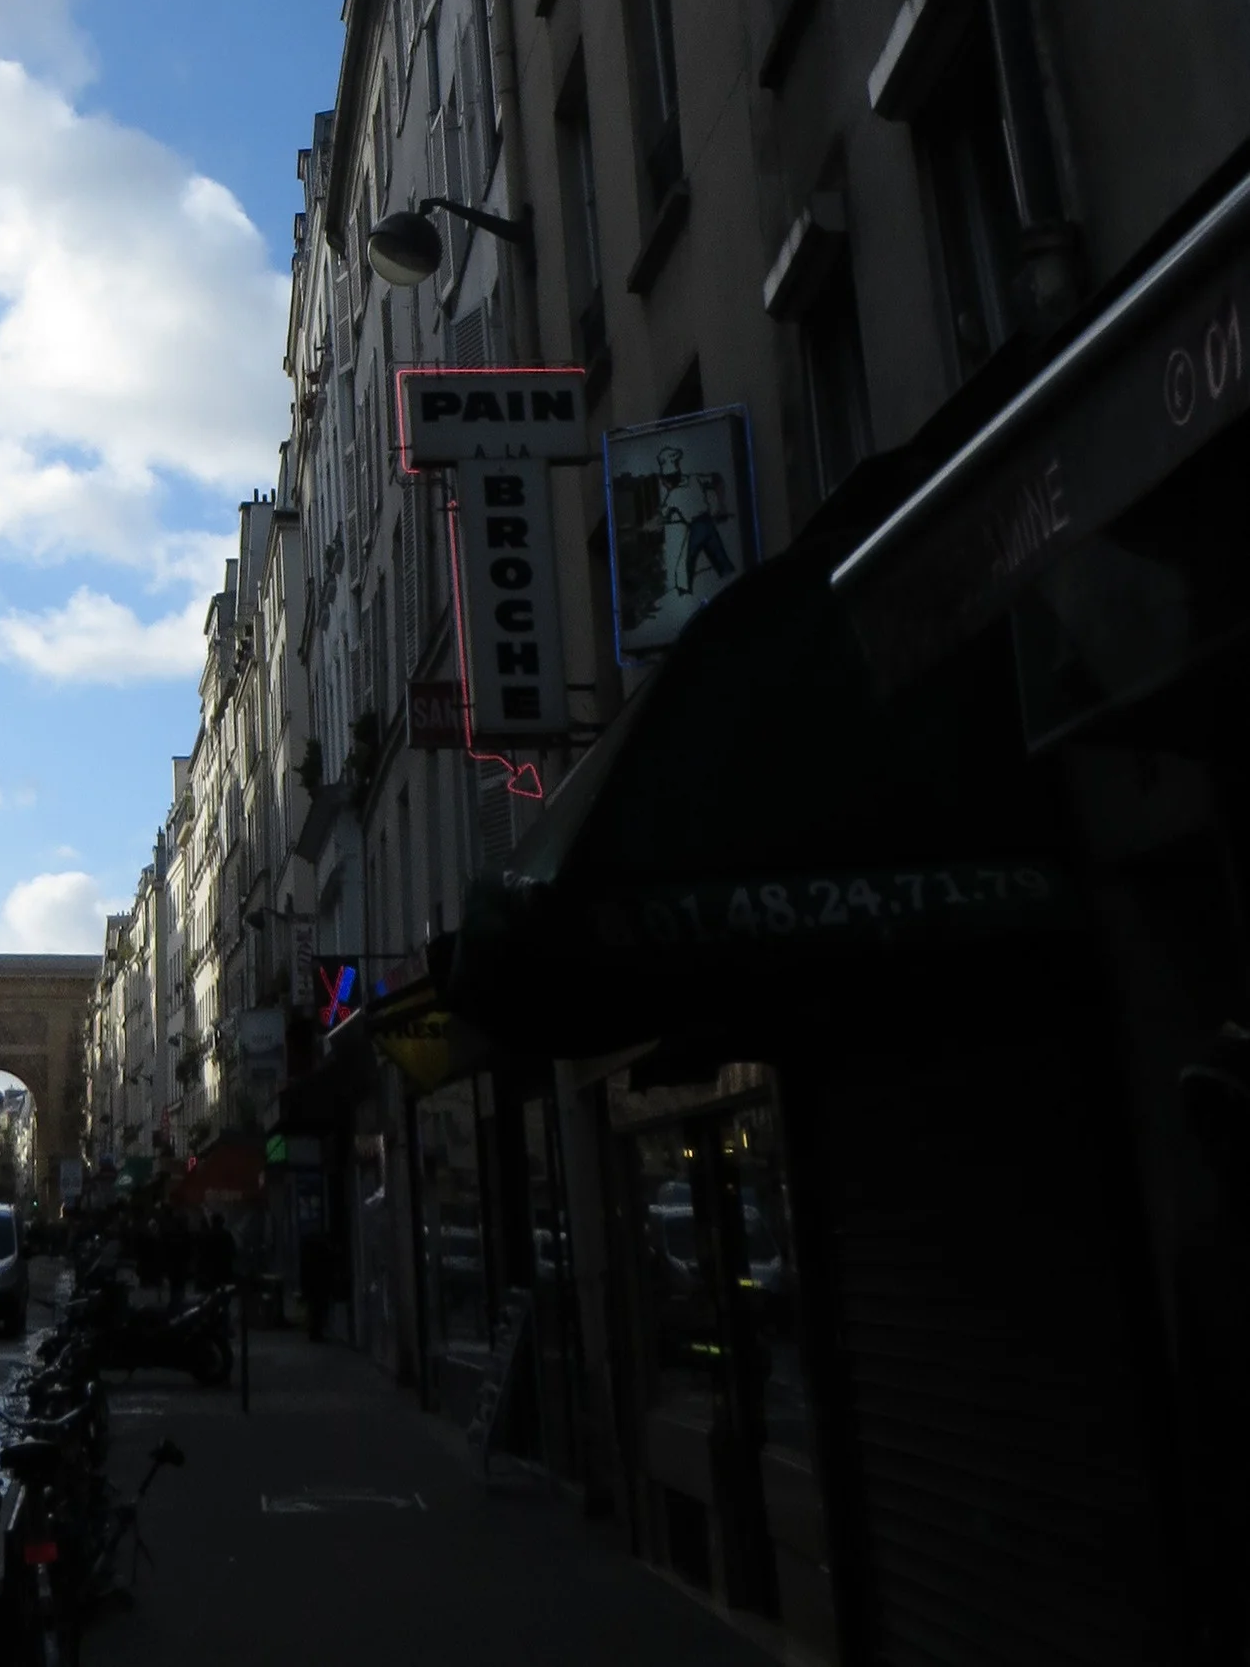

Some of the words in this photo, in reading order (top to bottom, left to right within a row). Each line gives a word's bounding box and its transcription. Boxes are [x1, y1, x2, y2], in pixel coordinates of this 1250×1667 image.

[421, 390, 575, 422] PAIN
[505, 442, 531, 459] LA
[483, 475, 541, 720] BROCHE
